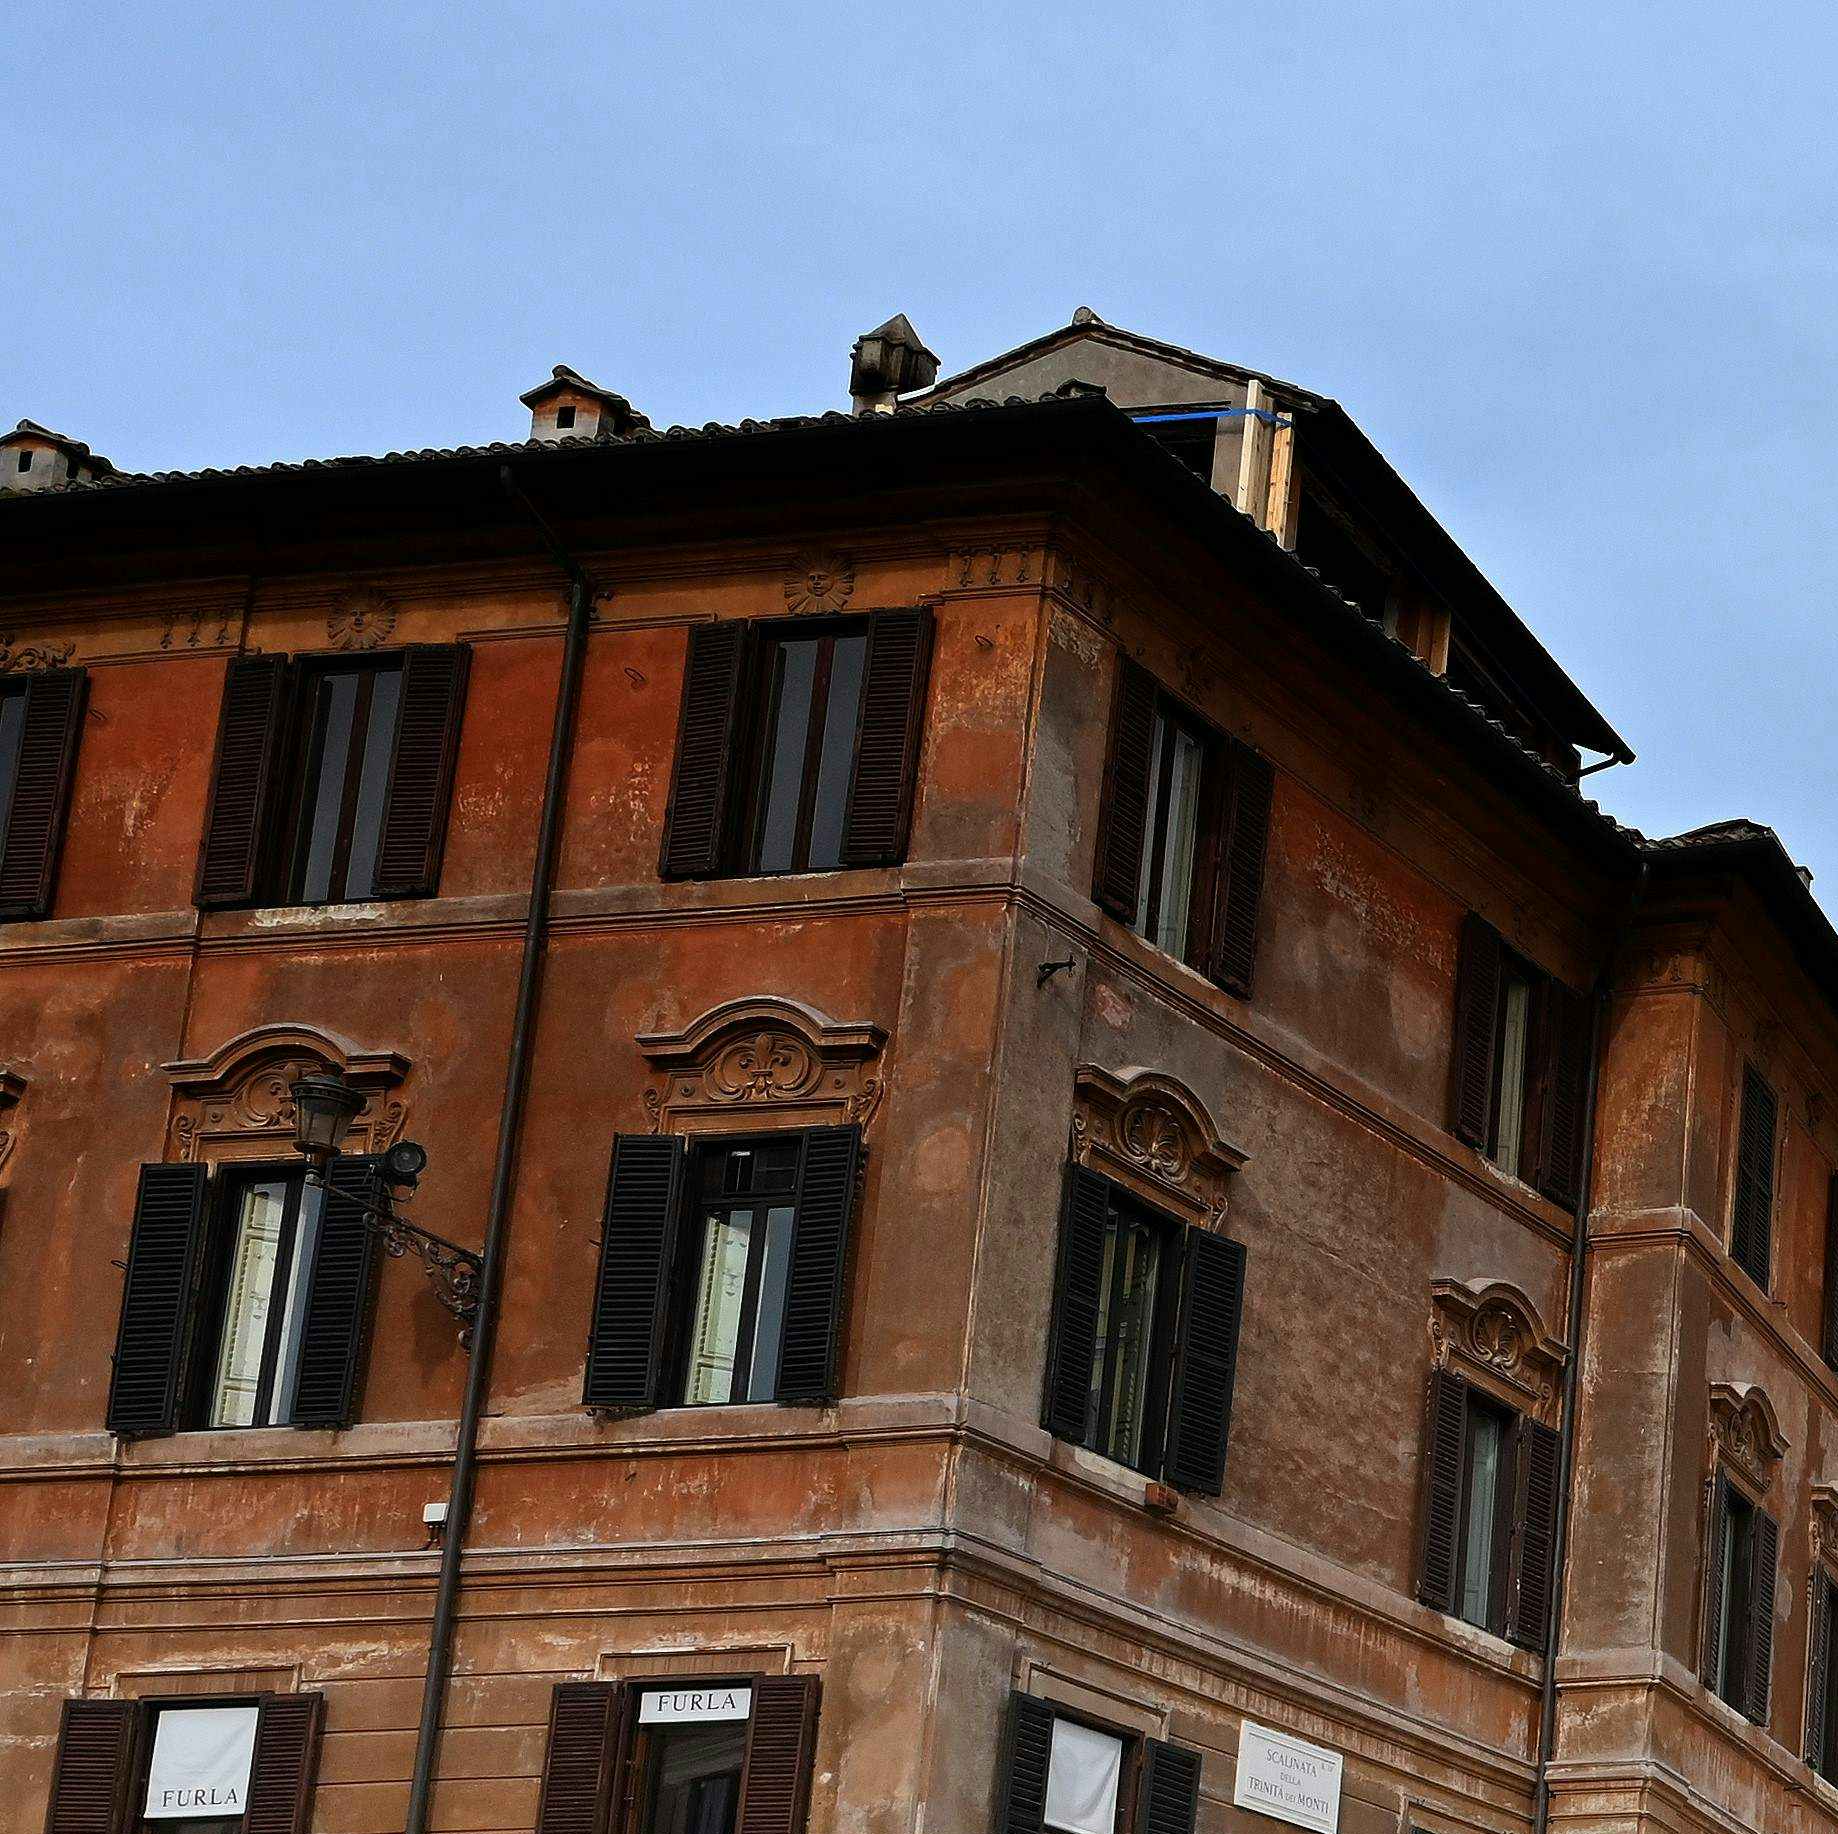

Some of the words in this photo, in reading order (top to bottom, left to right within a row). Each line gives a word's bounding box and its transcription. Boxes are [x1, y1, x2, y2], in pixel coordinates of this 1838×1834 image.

[656, 1690, 738, 1713] FURLA
[1266, 1748, 1318, 1778] SCALINATA
[161, 1787, 240, 1809] FURLA
[1296, 1793, 1330, 1815] MONTI
